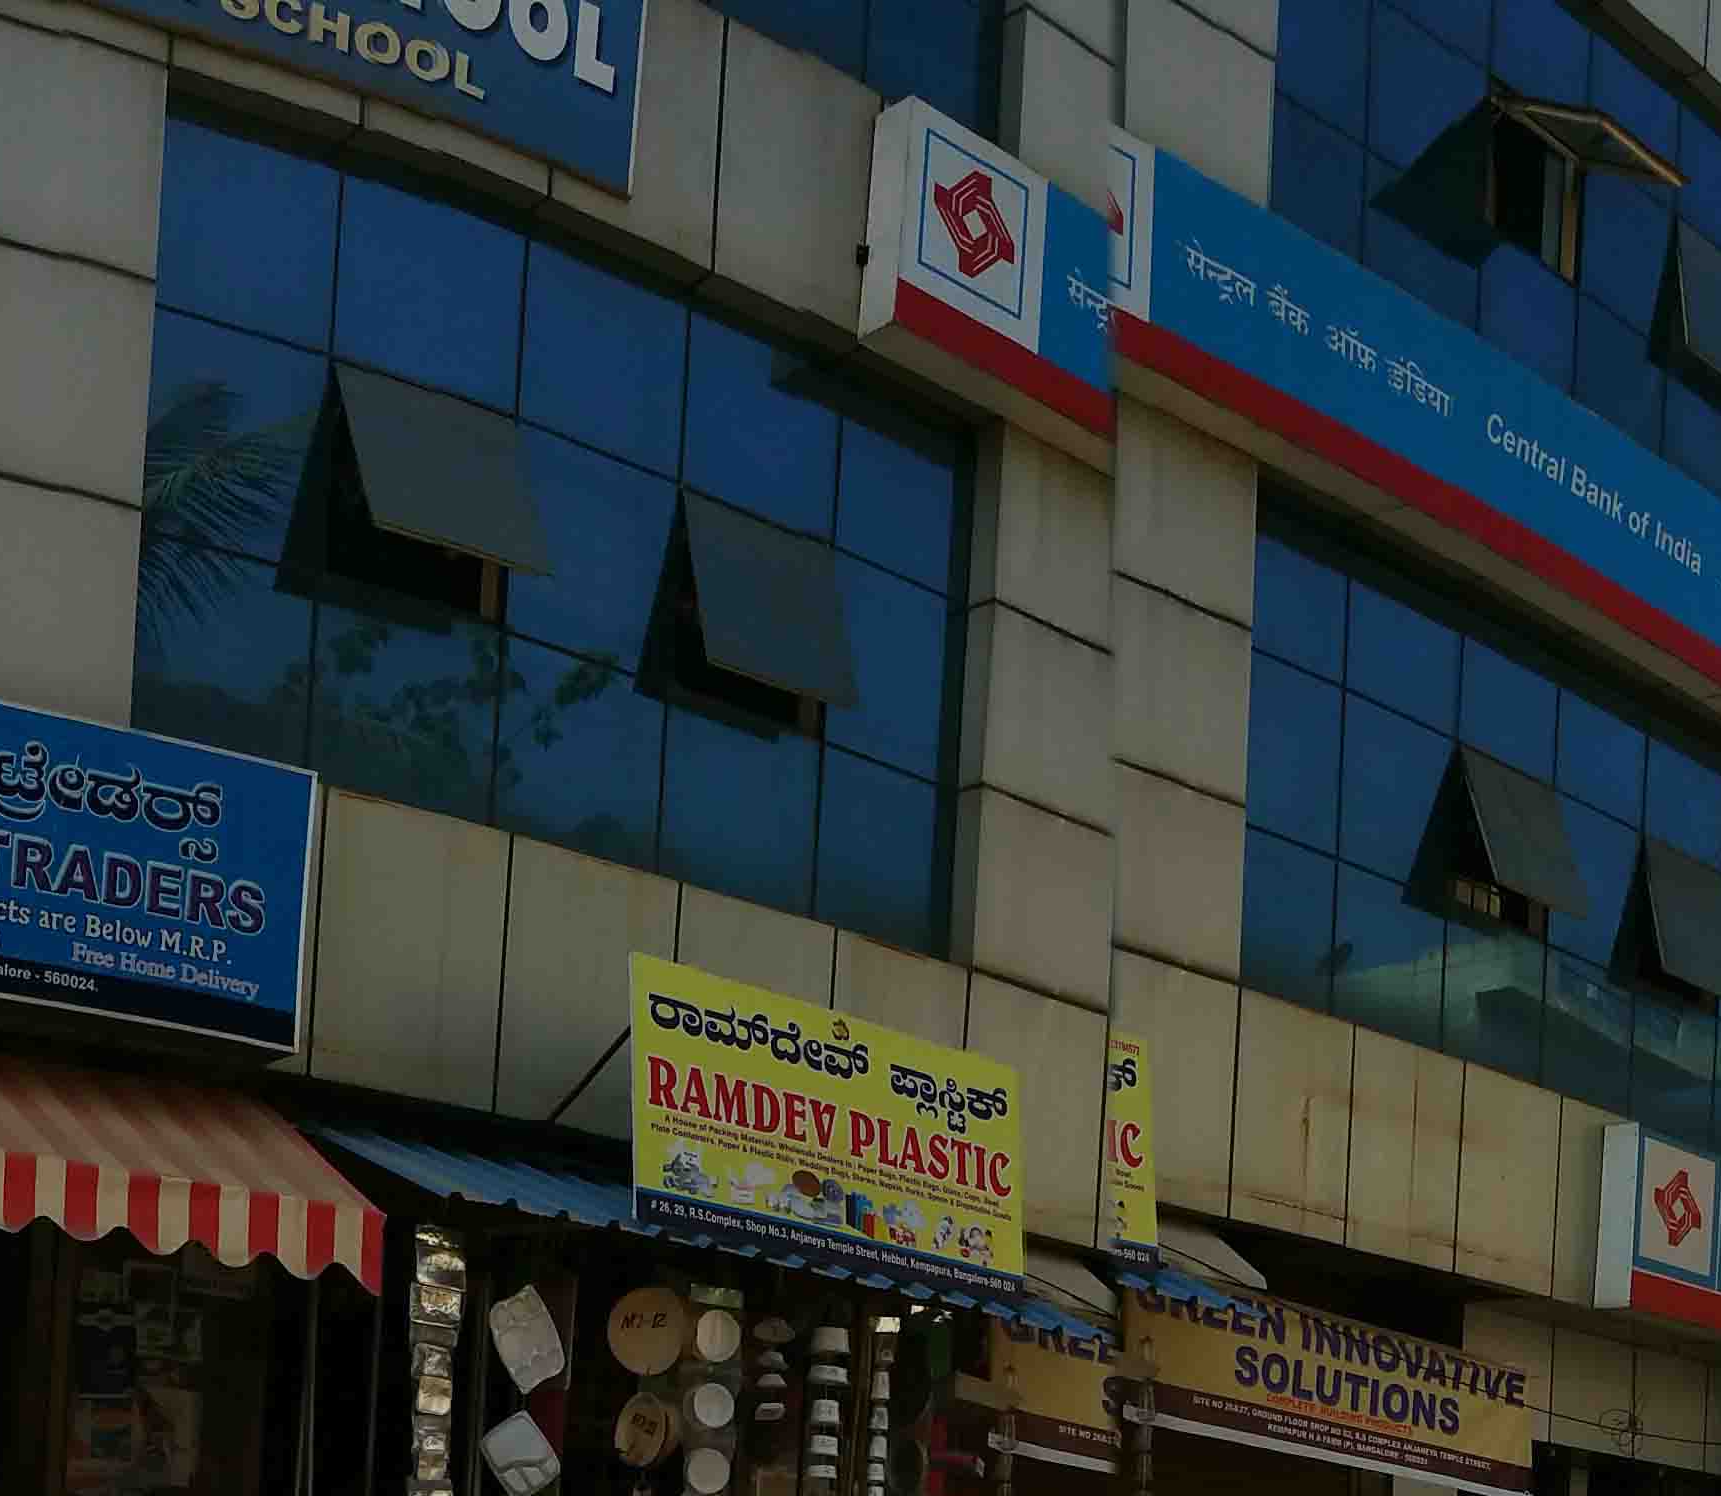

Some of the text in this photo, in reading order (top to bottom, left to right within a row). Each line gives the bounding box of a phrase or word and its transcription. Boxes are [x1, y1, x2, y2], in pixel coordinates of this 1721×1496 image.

[1486, 413, 1701, 576] Central Bank of India
[38, 908, 77, 933] are
[84, 912, 152, 950] Below
[160, 929, 233, 965] M.R.P.
[44, 969, 100, 993] 560024.
[71, 942, 260, 1000] Free Home Delivery
[647, 1055, 1012, 1198] RAMDEV PLASTIC
[745, 1219, 766, 1235] Shop
[790, 1230, 825, 1248] Anjaneya
[826, 1238, 855, 1255] Temple
[1299, 1312, 1526, 1408] INNOVATIVE
[1235, 1346, 1460, 1435] SOLUTIONS
[1284, 1414, 1308, 1428] FLOOR
